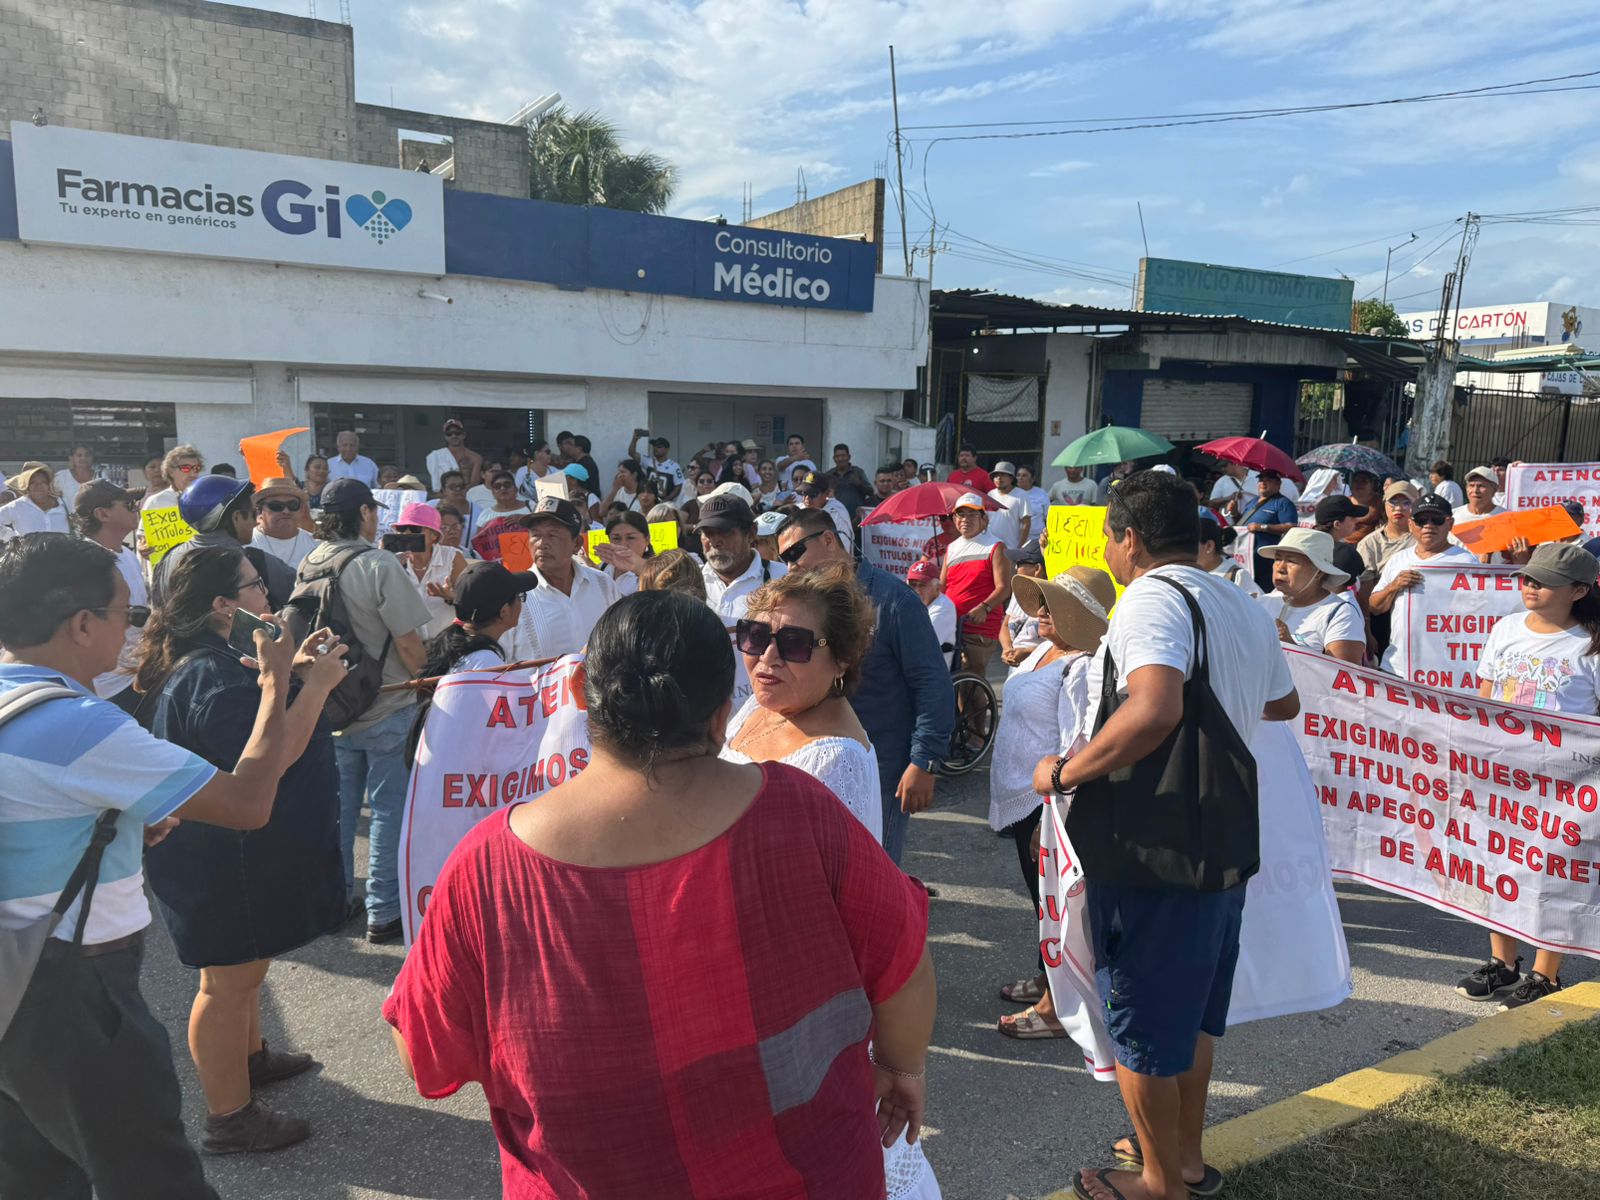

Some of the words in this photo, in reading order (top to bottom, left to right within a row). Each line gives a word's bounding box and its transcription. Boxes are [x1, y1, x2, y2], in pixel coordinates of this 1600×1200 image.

[57, 168, 255, 217] Farmacias
[59, 202, 78, 213] Tu
[83, 206, 141, 220] experto
[145, 212, 163, 222] en
[168, 213, 237, 229] genéricos
[715, 231, 832, 264] Consultorio
[714, 262, 831, 301] Médico
[1154, 265, 1230, 292] SERVICIO
[1233, 270, 1342, 299] AUTOMOTRIZ
[1458, 309, 1527, 331] CARTÓN
[1547, 372, 1567, 383] CAJAS
[1569, 373, 1578, 383] DE
[872, 535, 910, 548] EXIGIMOS
[880, 550, 913, 562] TITULOS
[1447, 642, 1486, 661] TIT
[1414, 669, 1453, 688] CON
[1332, 670, 1562, 748] ATENCIÓN
[443, 748, 590, 808] EXIGIMOS
[1304, 713, 1438, 764] EXIGIMOS
[1450, 750, 1598, 812] NUESTRO
[1315, 785, 1338, 807] N
[1347, 791, 1435, 830] APEGO
[1445, 818, 1477, 846] AL
[1330, 751, 1449, 801] TITULOS
[1460, 789, 1477, 811] A
[1489, 793, 1581, 847] INSUS
[1380, 836, 1414, 865] DE
[1425, 847, 1520, 902] AMLO
